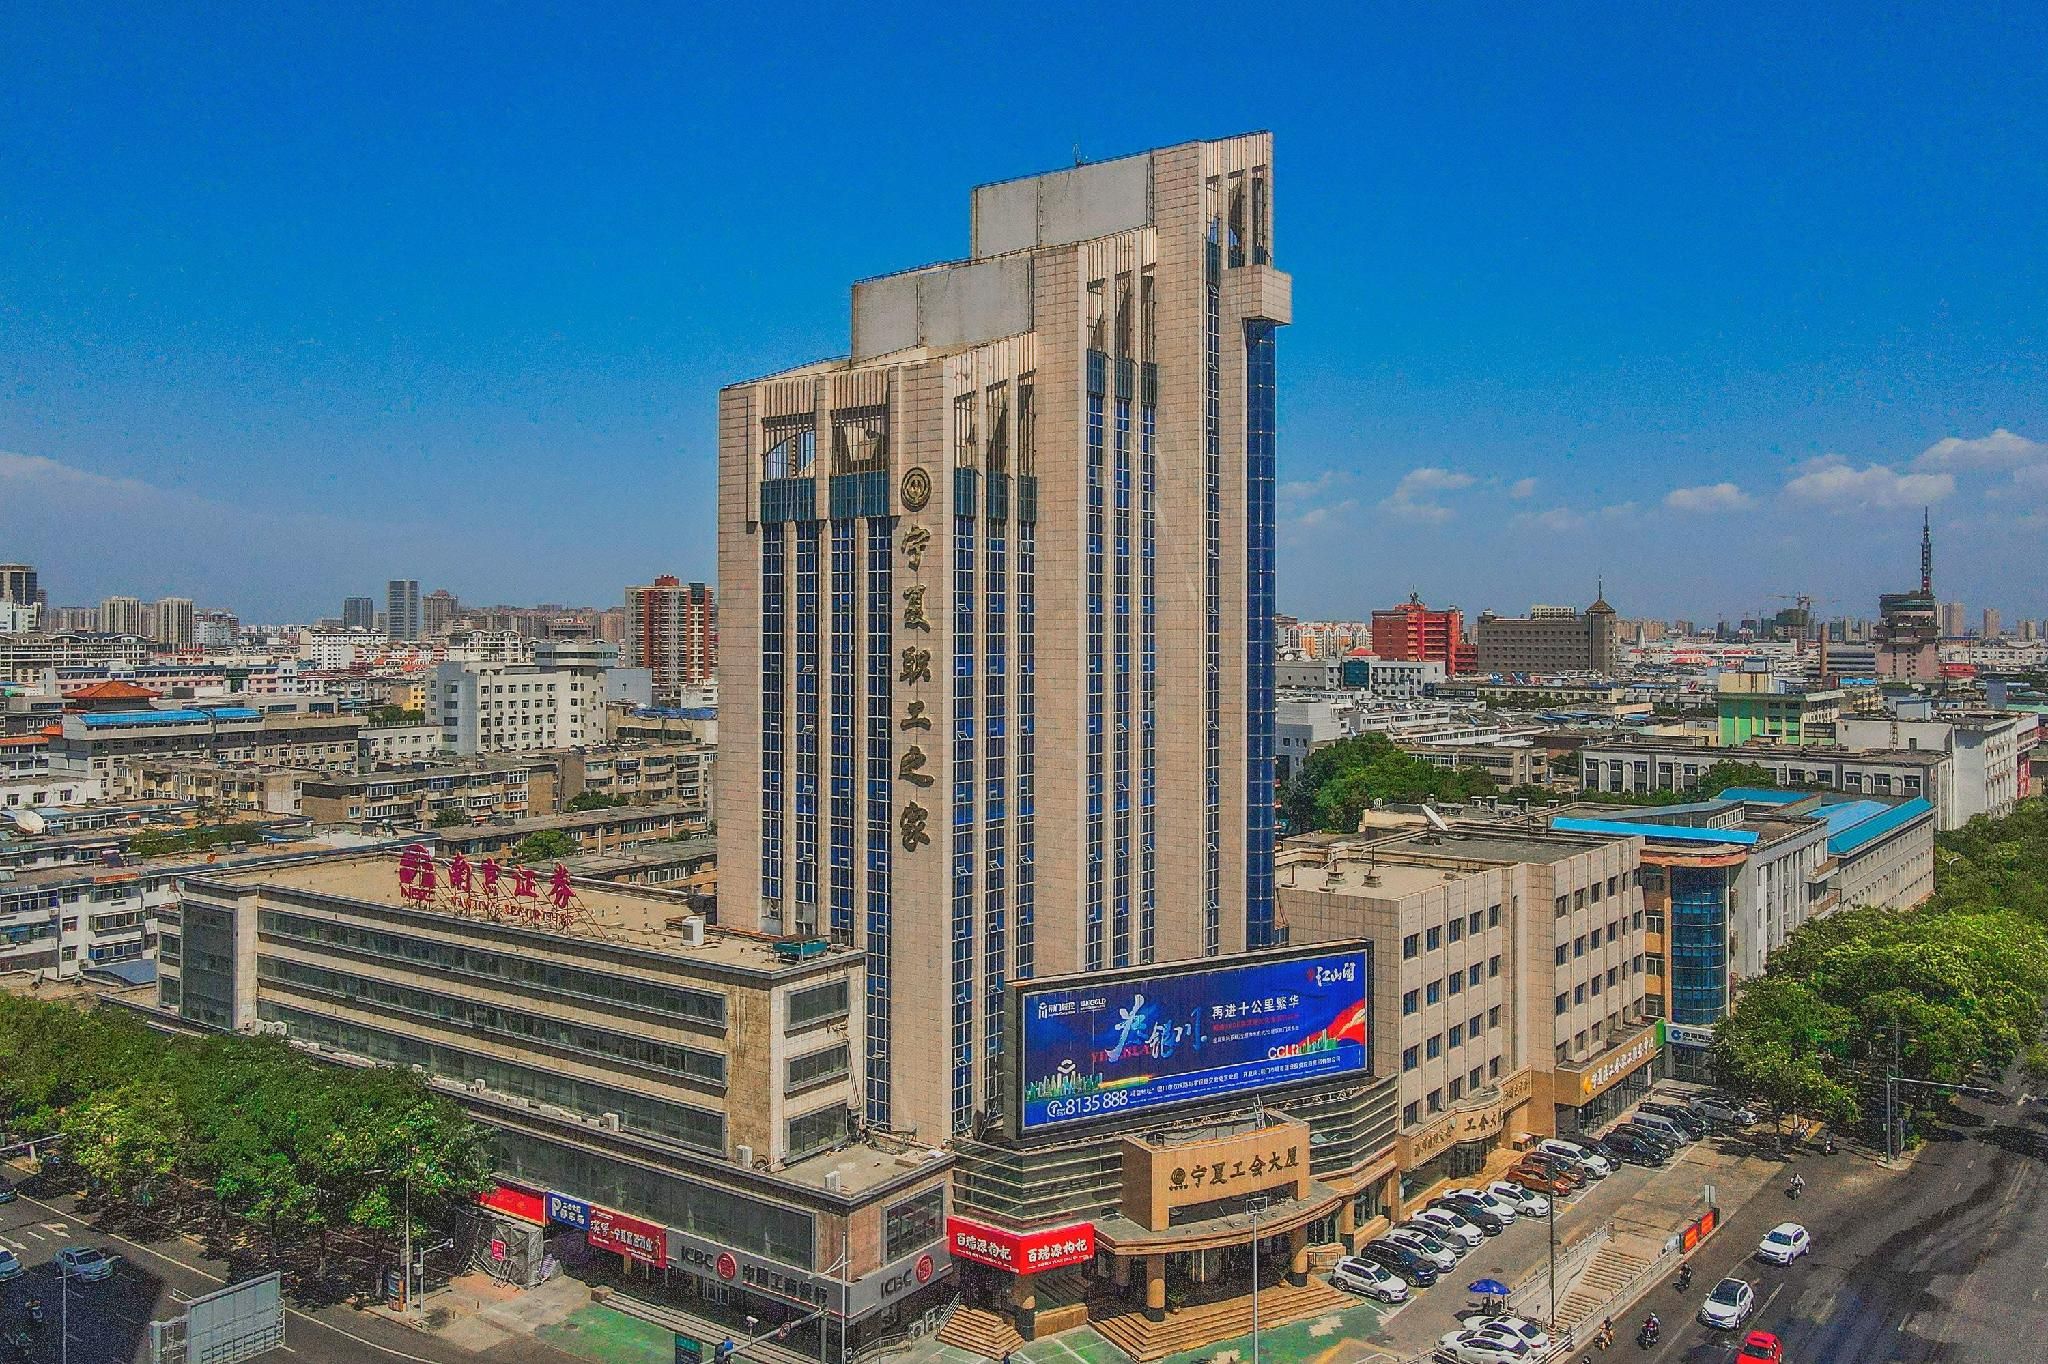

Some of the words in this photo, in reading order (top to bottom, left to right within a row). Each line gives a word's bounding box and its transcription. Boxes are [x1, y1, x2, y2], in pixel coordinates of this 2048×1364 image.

[1211, 995, 1299, 1020] 再进十公里繁华
[1066, 1094, 1100, 1115] 8135
[1103, 1089, 1128, 1108] 888
[1191, 1145, 1299, 1188] 宁夏工会大厦
[681, 1245, 713, 1270] ICBC
[957, 1232, 1011, 1261] 百瑞源枸杞
[1028, 1237, 1088, 1262] 百瑞源枸杞
[742, 1264, 828, 1304] 中国工商银行
[881, 1268, 912, 1298] ICBC
